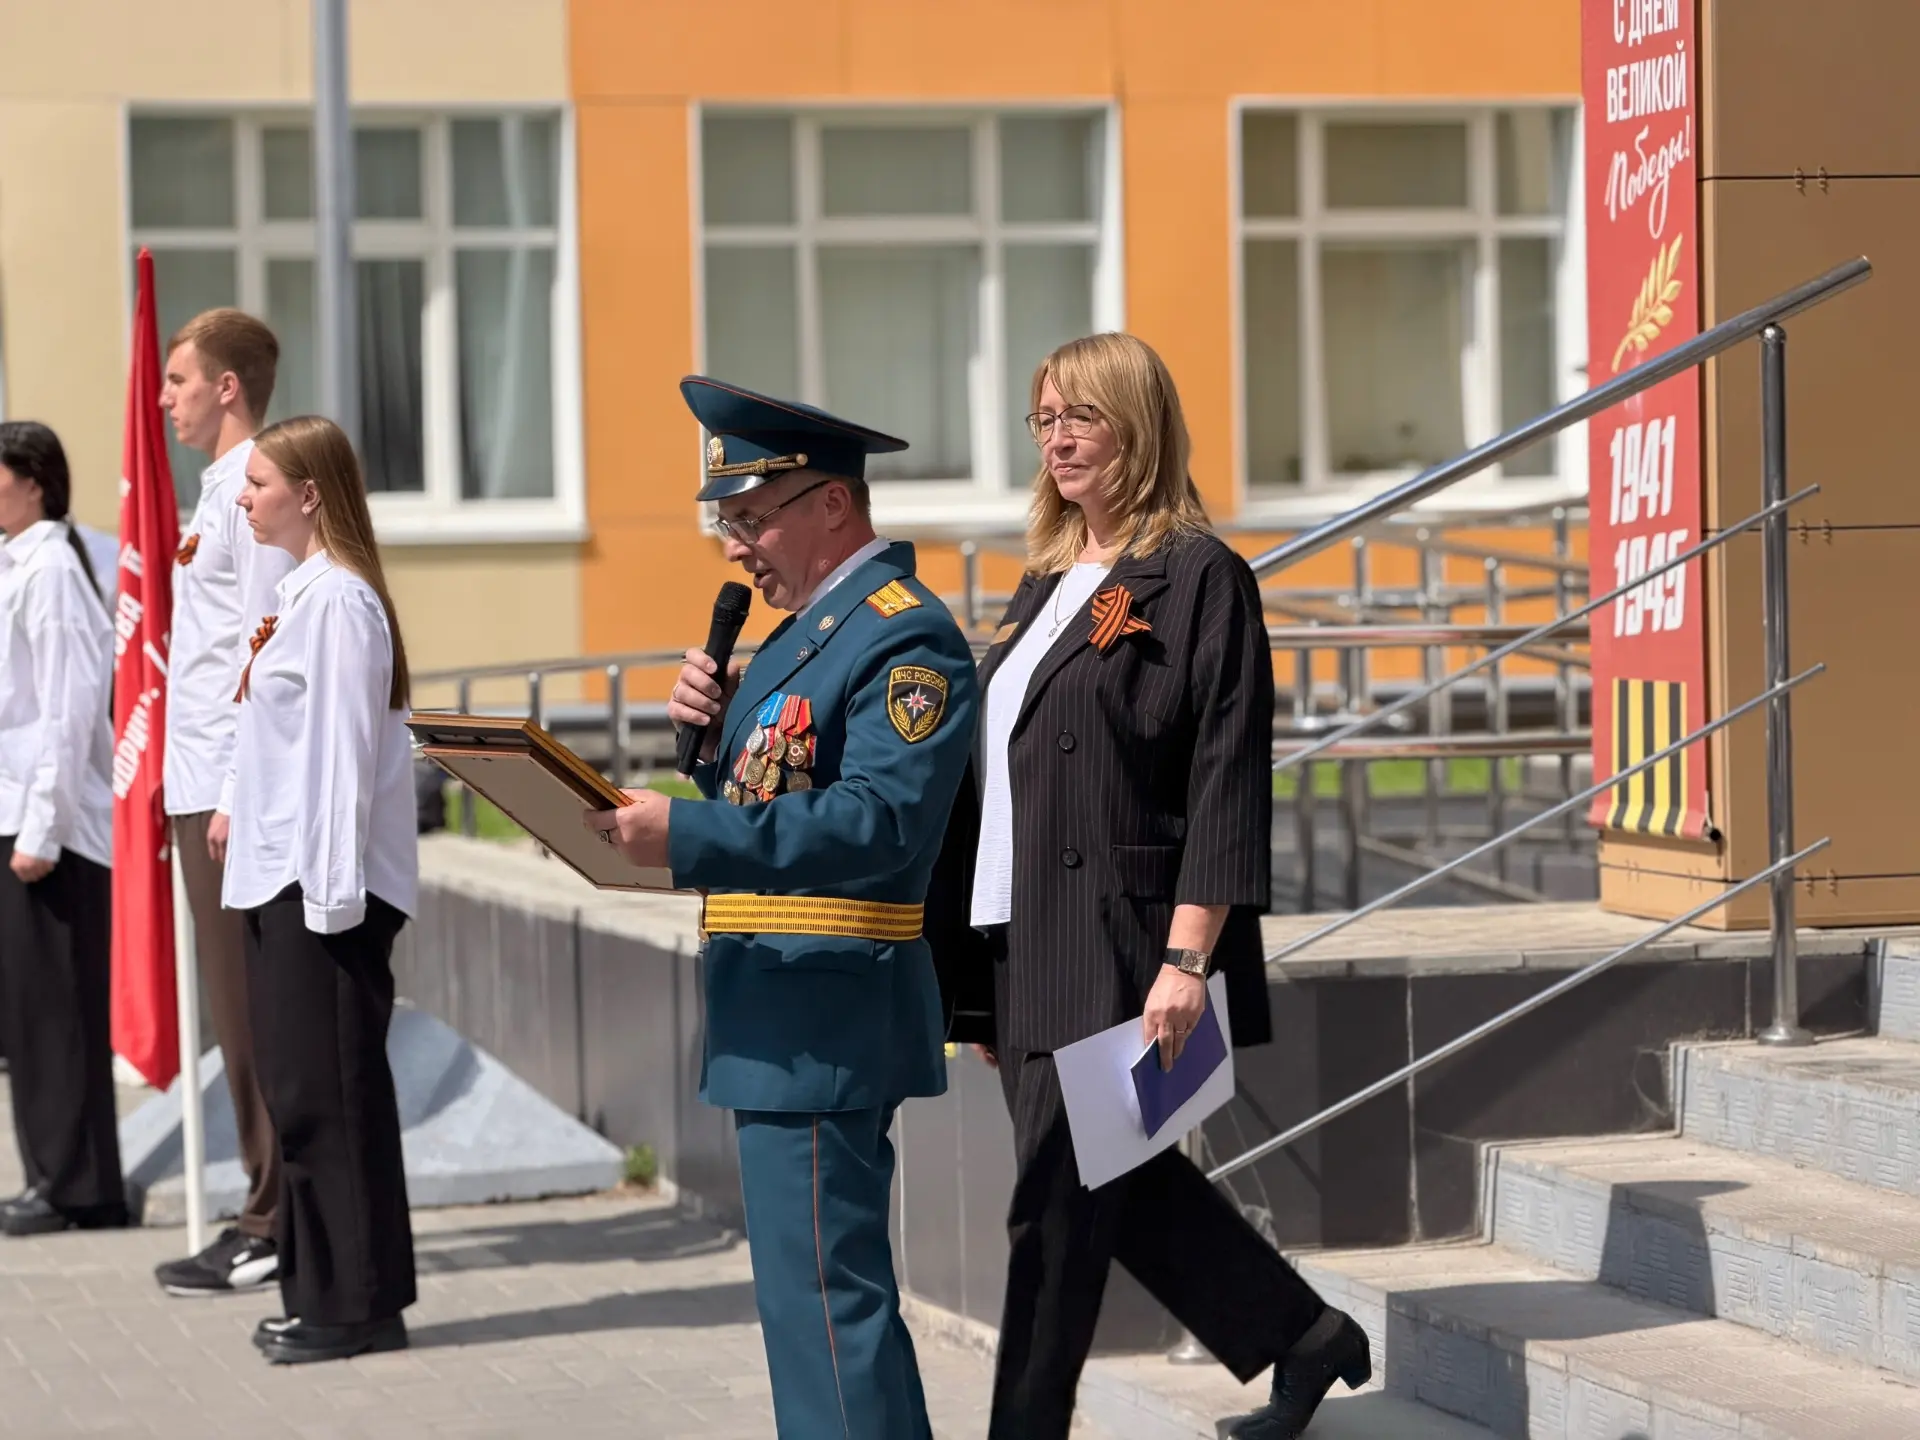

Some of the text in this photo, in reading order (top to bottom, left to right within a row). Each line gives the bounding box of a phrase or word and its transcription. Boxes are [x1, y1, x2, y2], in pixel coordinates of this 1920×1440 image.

[1613, 0, 1625, 44] С
[1607, 39, 1687, 123] ВЕЛИКОЙ
[1604, 115, 1690, 239] Победы!
[1609, 415, 1676, 526] 1941
[1614, 528, 1688, 638] 1945
[894, 670, 944, 688] МЧС РОССИИ
